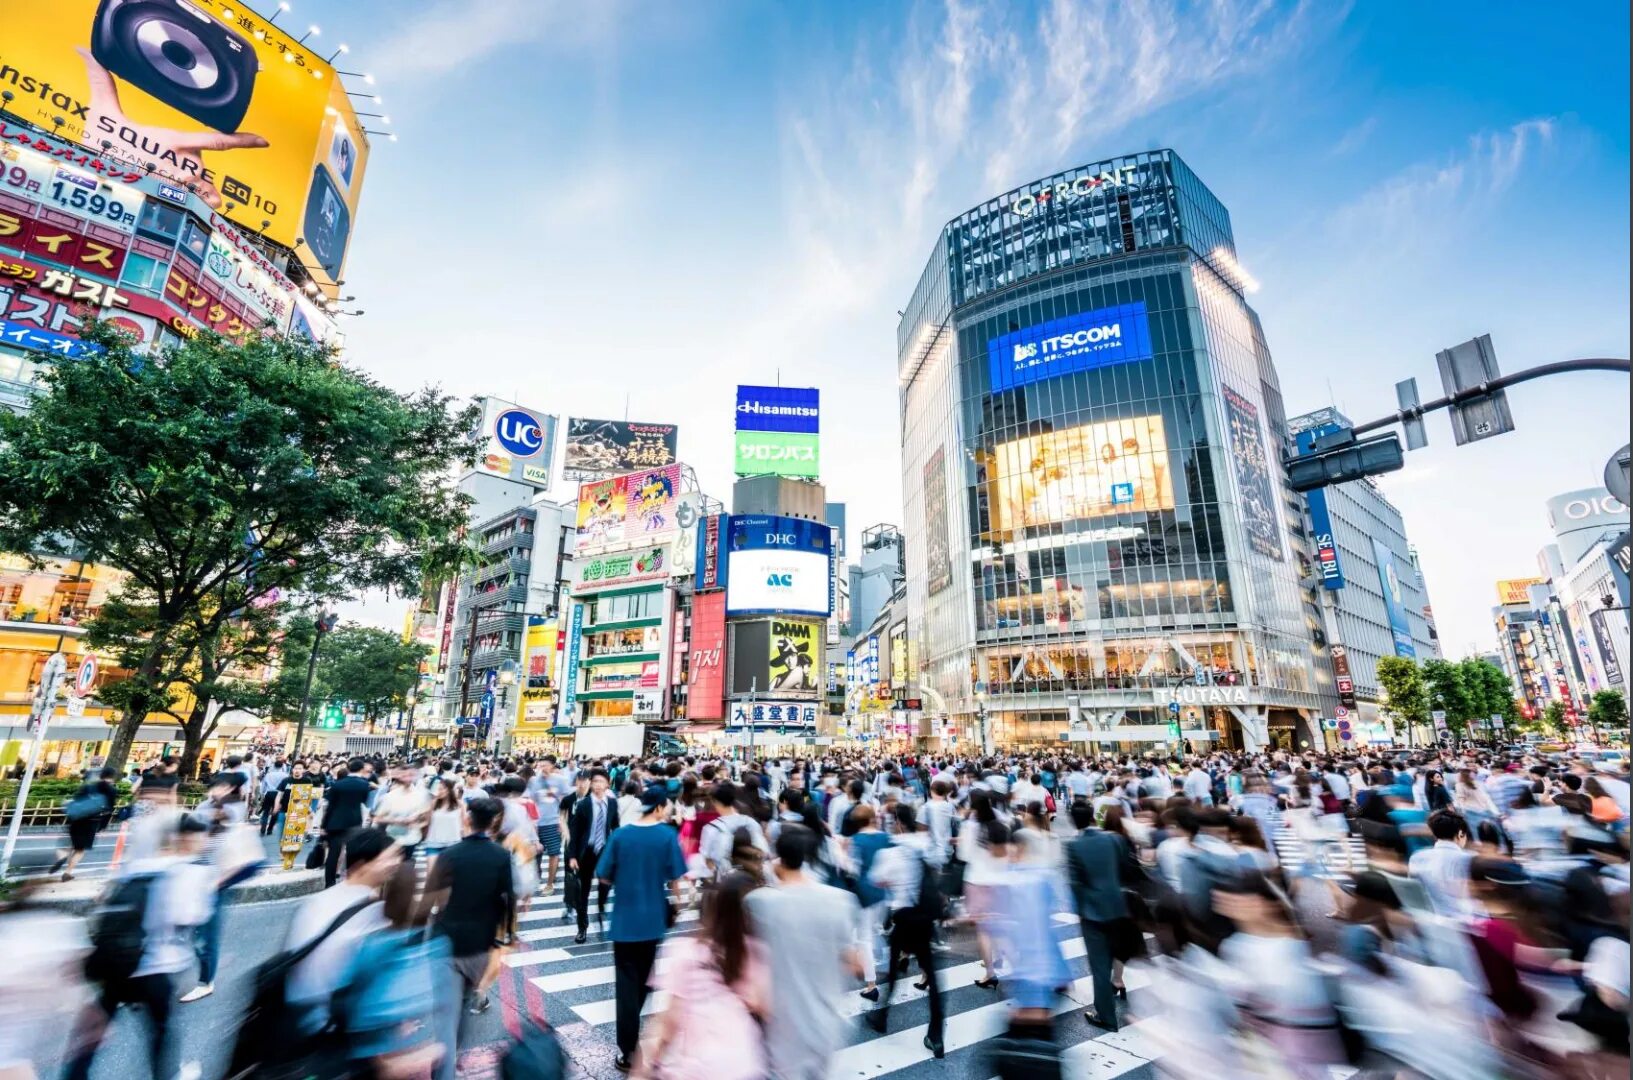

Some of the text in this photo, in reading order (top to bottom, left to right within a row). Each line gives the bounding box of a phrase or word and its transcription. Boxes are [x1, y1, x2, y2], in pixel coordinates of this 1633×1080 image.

[0, 56, 277, 215] nstax SQUARE SQ 10
[37, 109, 91, 139] HYRID
[1013, 165, 1136, 221] QFRONT
[0, 213, 115, 269] ライス
[41, 270, 129, 308] ガスト
[166, 270, 254, 340] コンタク
[737, 400, 818, 416] Hisamitsu
[501, 416, 540, 448] UC
[740, 443, 815, 462] サロンパス
[526, 470, 546, 480] VISA
[765, 533, 797, 545] DHC
[1316, 534, 1339, 580] SEIBU
[767, 574, 793, 587] AC
[772, 621, 811, 639] DMM
[691, 640, 722, 685] クスリ
[1157, 687, 1247, 703] TSUTAYA
[735, 705, 815, 722] 大盛堂書店
